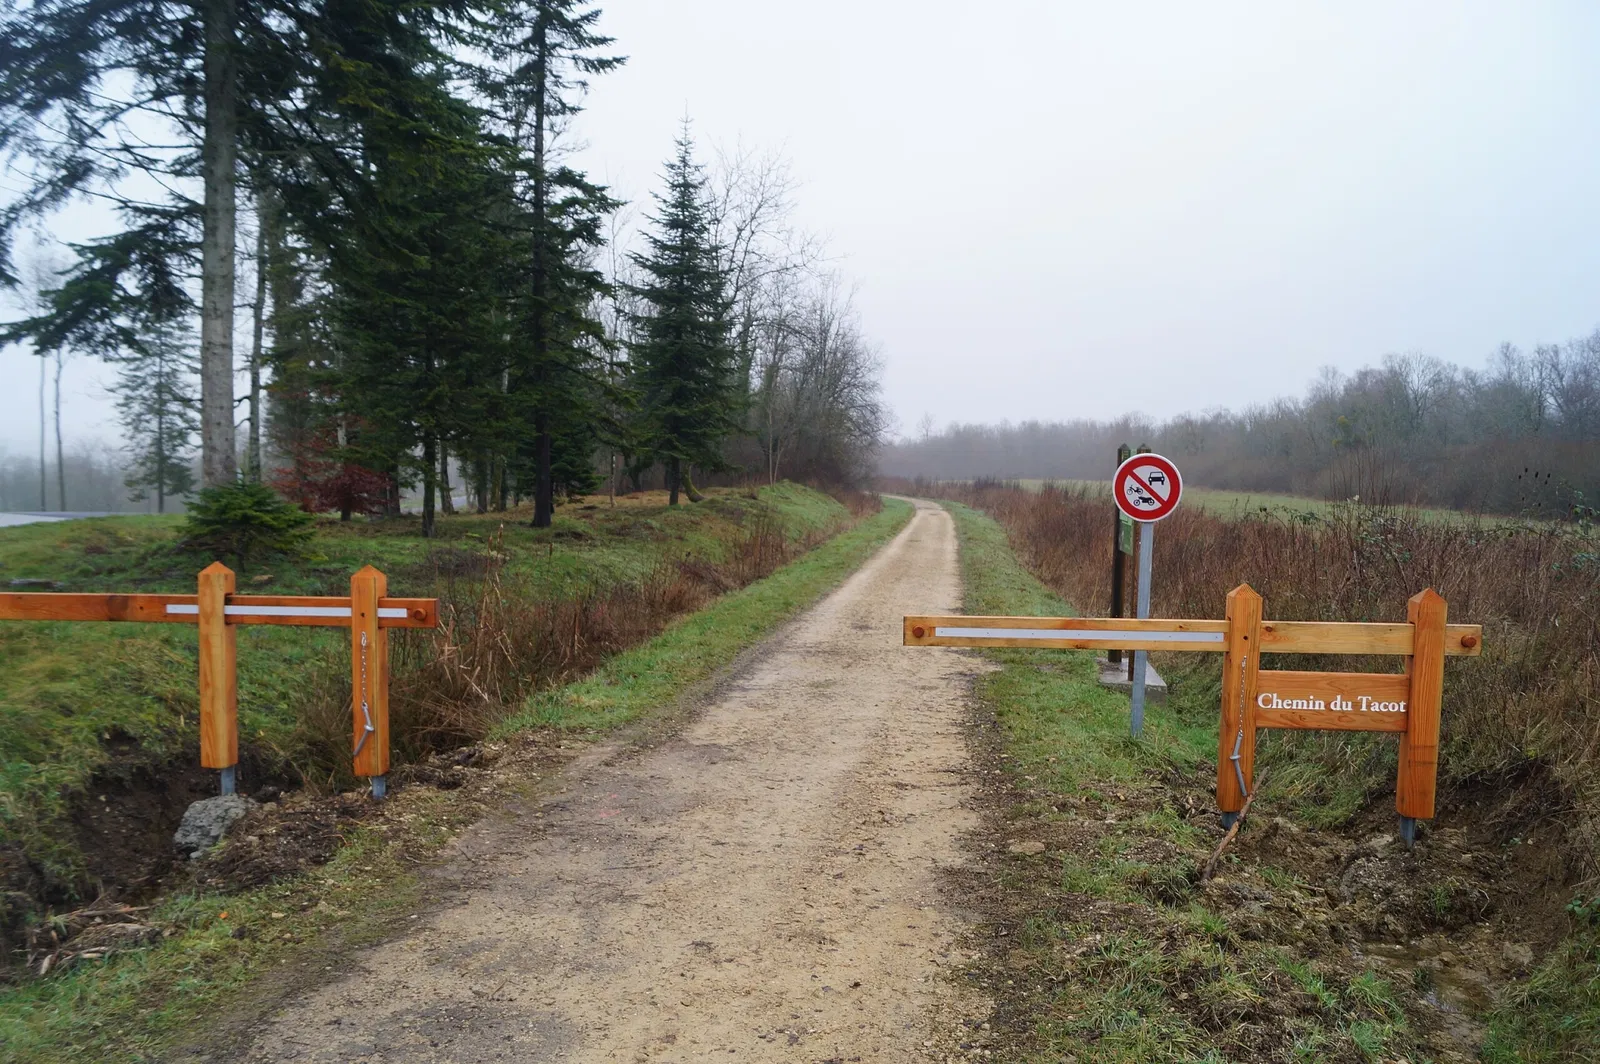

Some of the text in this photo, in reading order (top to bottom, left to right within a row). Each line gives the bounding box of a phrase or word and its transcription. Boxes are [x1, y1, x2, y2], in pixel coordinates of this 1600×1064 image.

[1257, 692, 1407, 712] Chemin du Tacot
